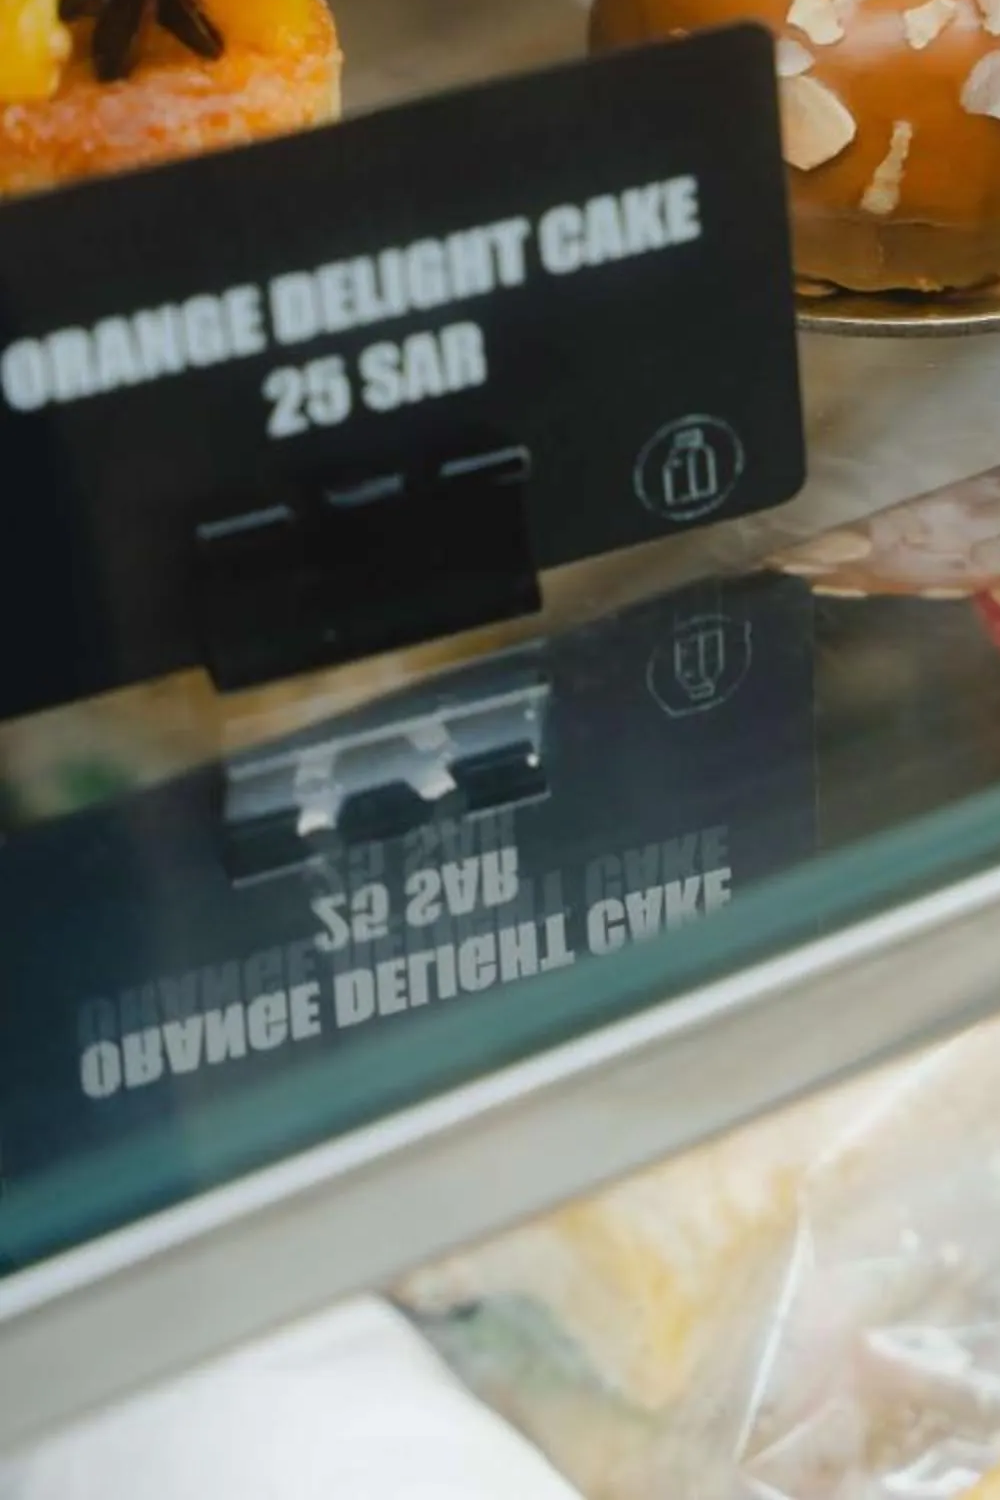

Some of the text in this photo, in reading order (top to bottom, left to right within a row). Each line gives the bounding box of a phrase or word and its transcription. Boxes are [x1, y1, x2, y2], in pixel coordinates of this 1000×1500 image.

[1, 175, 702, 412] ORANGE DELIGHT CAKE
[263, 321, 487, 438] 25 SAR
